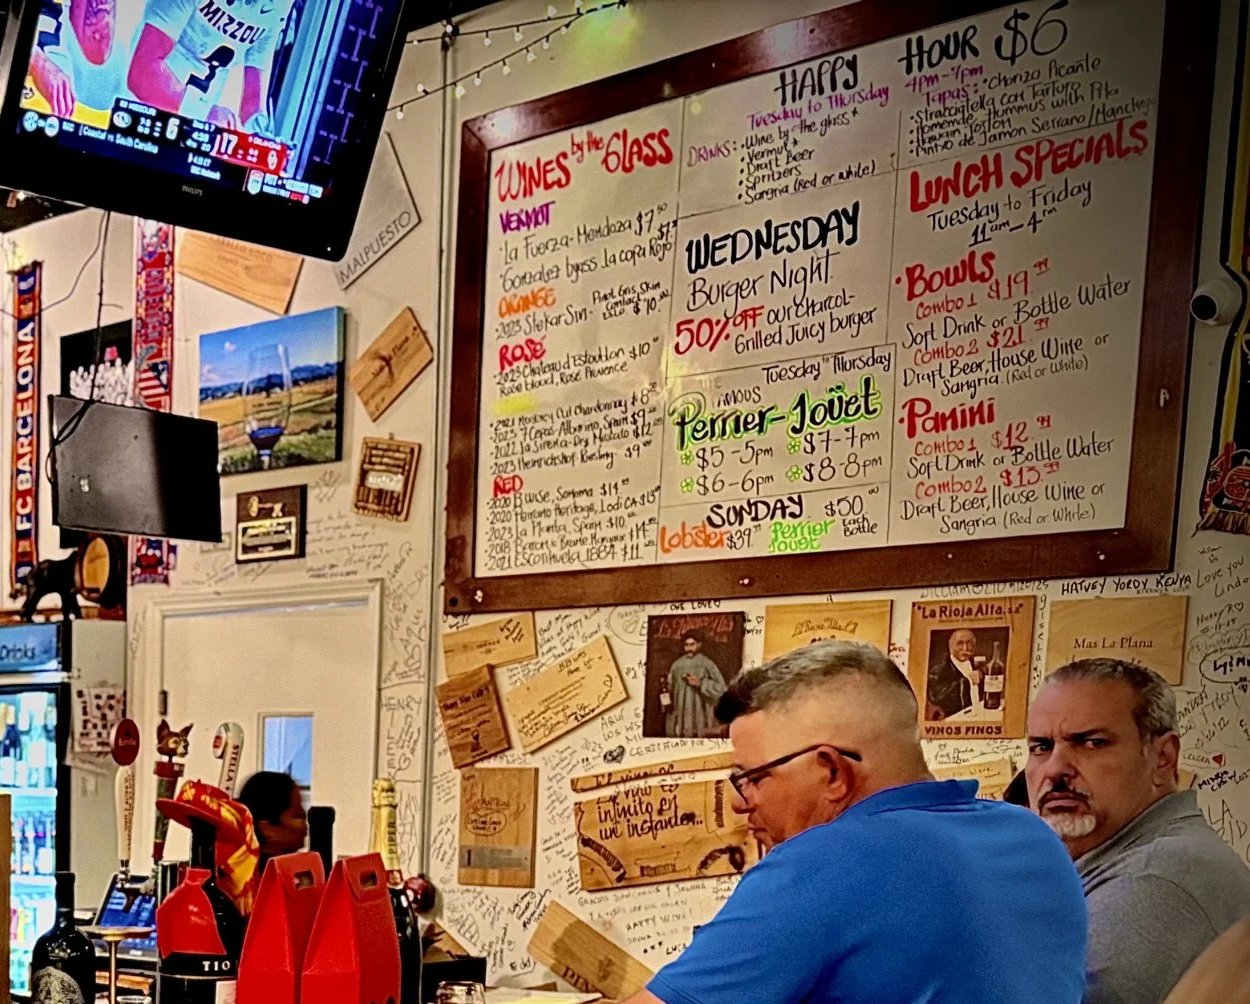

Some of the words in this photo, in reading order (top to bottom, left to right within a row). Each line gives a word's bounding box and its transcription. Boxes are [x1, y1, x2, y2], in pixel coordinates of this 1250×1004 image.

[774, 54, 859, 106] HAPPY
[898, 24, 980, 75] HOUR
[995, 0, 1069, 66] $6
[748, 107, 803, 132] Tuesday
[807, 99, 822, 114] to
[826, 82, 890, 109] Thursday
[745, 131, 775, 150] Wine
[779, 125, 790, 143] by
[786, 148, 815, 166] Beer
[495, 152, 571, 202] WINES
[822, 171, 835, 186] or
[910, 150, 1003, 213] LUNCH
[1010, 117, 1149, 188] SPECIALS
[927, 197, 1000, 233] Tuesday
[1003, 194, 1022, 212] to
[1027, 176, 1092, 208] Friday
[339, 210, 412, 284] MALPUESTO
[685, 200, 860, 274] WEDNESDAY
[687, 275, 764, 320] Burger
[902, 322, 938, 349] Soft
[943, 313, 986, 339] Drink
[992, 316, 1007, 329] or
[1014, 292, 1071, 325] Bottle
[1078, 272, 1131, 306] Water
[673, 317, 730, 356] 50%
[731, 304, 765, 331] OFF
[766, 303, 791, 326] our
[734, 323, 783, 355] Grilled
[785, 318, 826, 346] Juicy
[830, 306, 878, 339] burger
[761, 359, 821, 386] Tuesday
[830, 347, 892, 375] Thursday
[903, 362, 946, 388] Draft
[988, 347, 1038, 375] House
[1041, 335, 1083, 360] Wine
[1094, 333, 1109, 346] or
[941, 374, 999, 399] Sangria
[1035, 364, 1048, 378] or
[16, 321, 34, 491] BARCELONA
[900, 396, 997, 438] Panini
[906, 456, 942, 480] Soft
[945, 452, 986, 472] Drink
[992, 456, 1005, 467] or
[1011, 439, 1061, 466] Bottle
[1067, 431, 1115, 459] Water
[493, 474, 523, 498] RED
[900, 499, 946, 521] Draft
[992, 484, 1038, 510] House
[1045, 481, 1086, 502] Wine
[1091, 483, 1105, 495] or
[16, 497, 32, 531] FC
[706, 494, 803, 529] SUNDAY
[939, 514, 996, 536] Sangria
[1036, 511, 1049, 523] or
[660, 521, 732, 554] Lobster
[939, 603, 974, 620] Rioja
[0, 642, 37, 662] Drinks
[1074, 637, 1098, 649] Mas
[1102, 637, 1116, 649] La
[1120, 636, 1153, 649] Plana
[925, 726, 961, 735] VINOS
[965, 725, 1002, 735] FINOS
[227, 744, 239, 783] STELLA
[387, 821, 398, 855] PIPER
[202, 960, 231, 971] TIO
